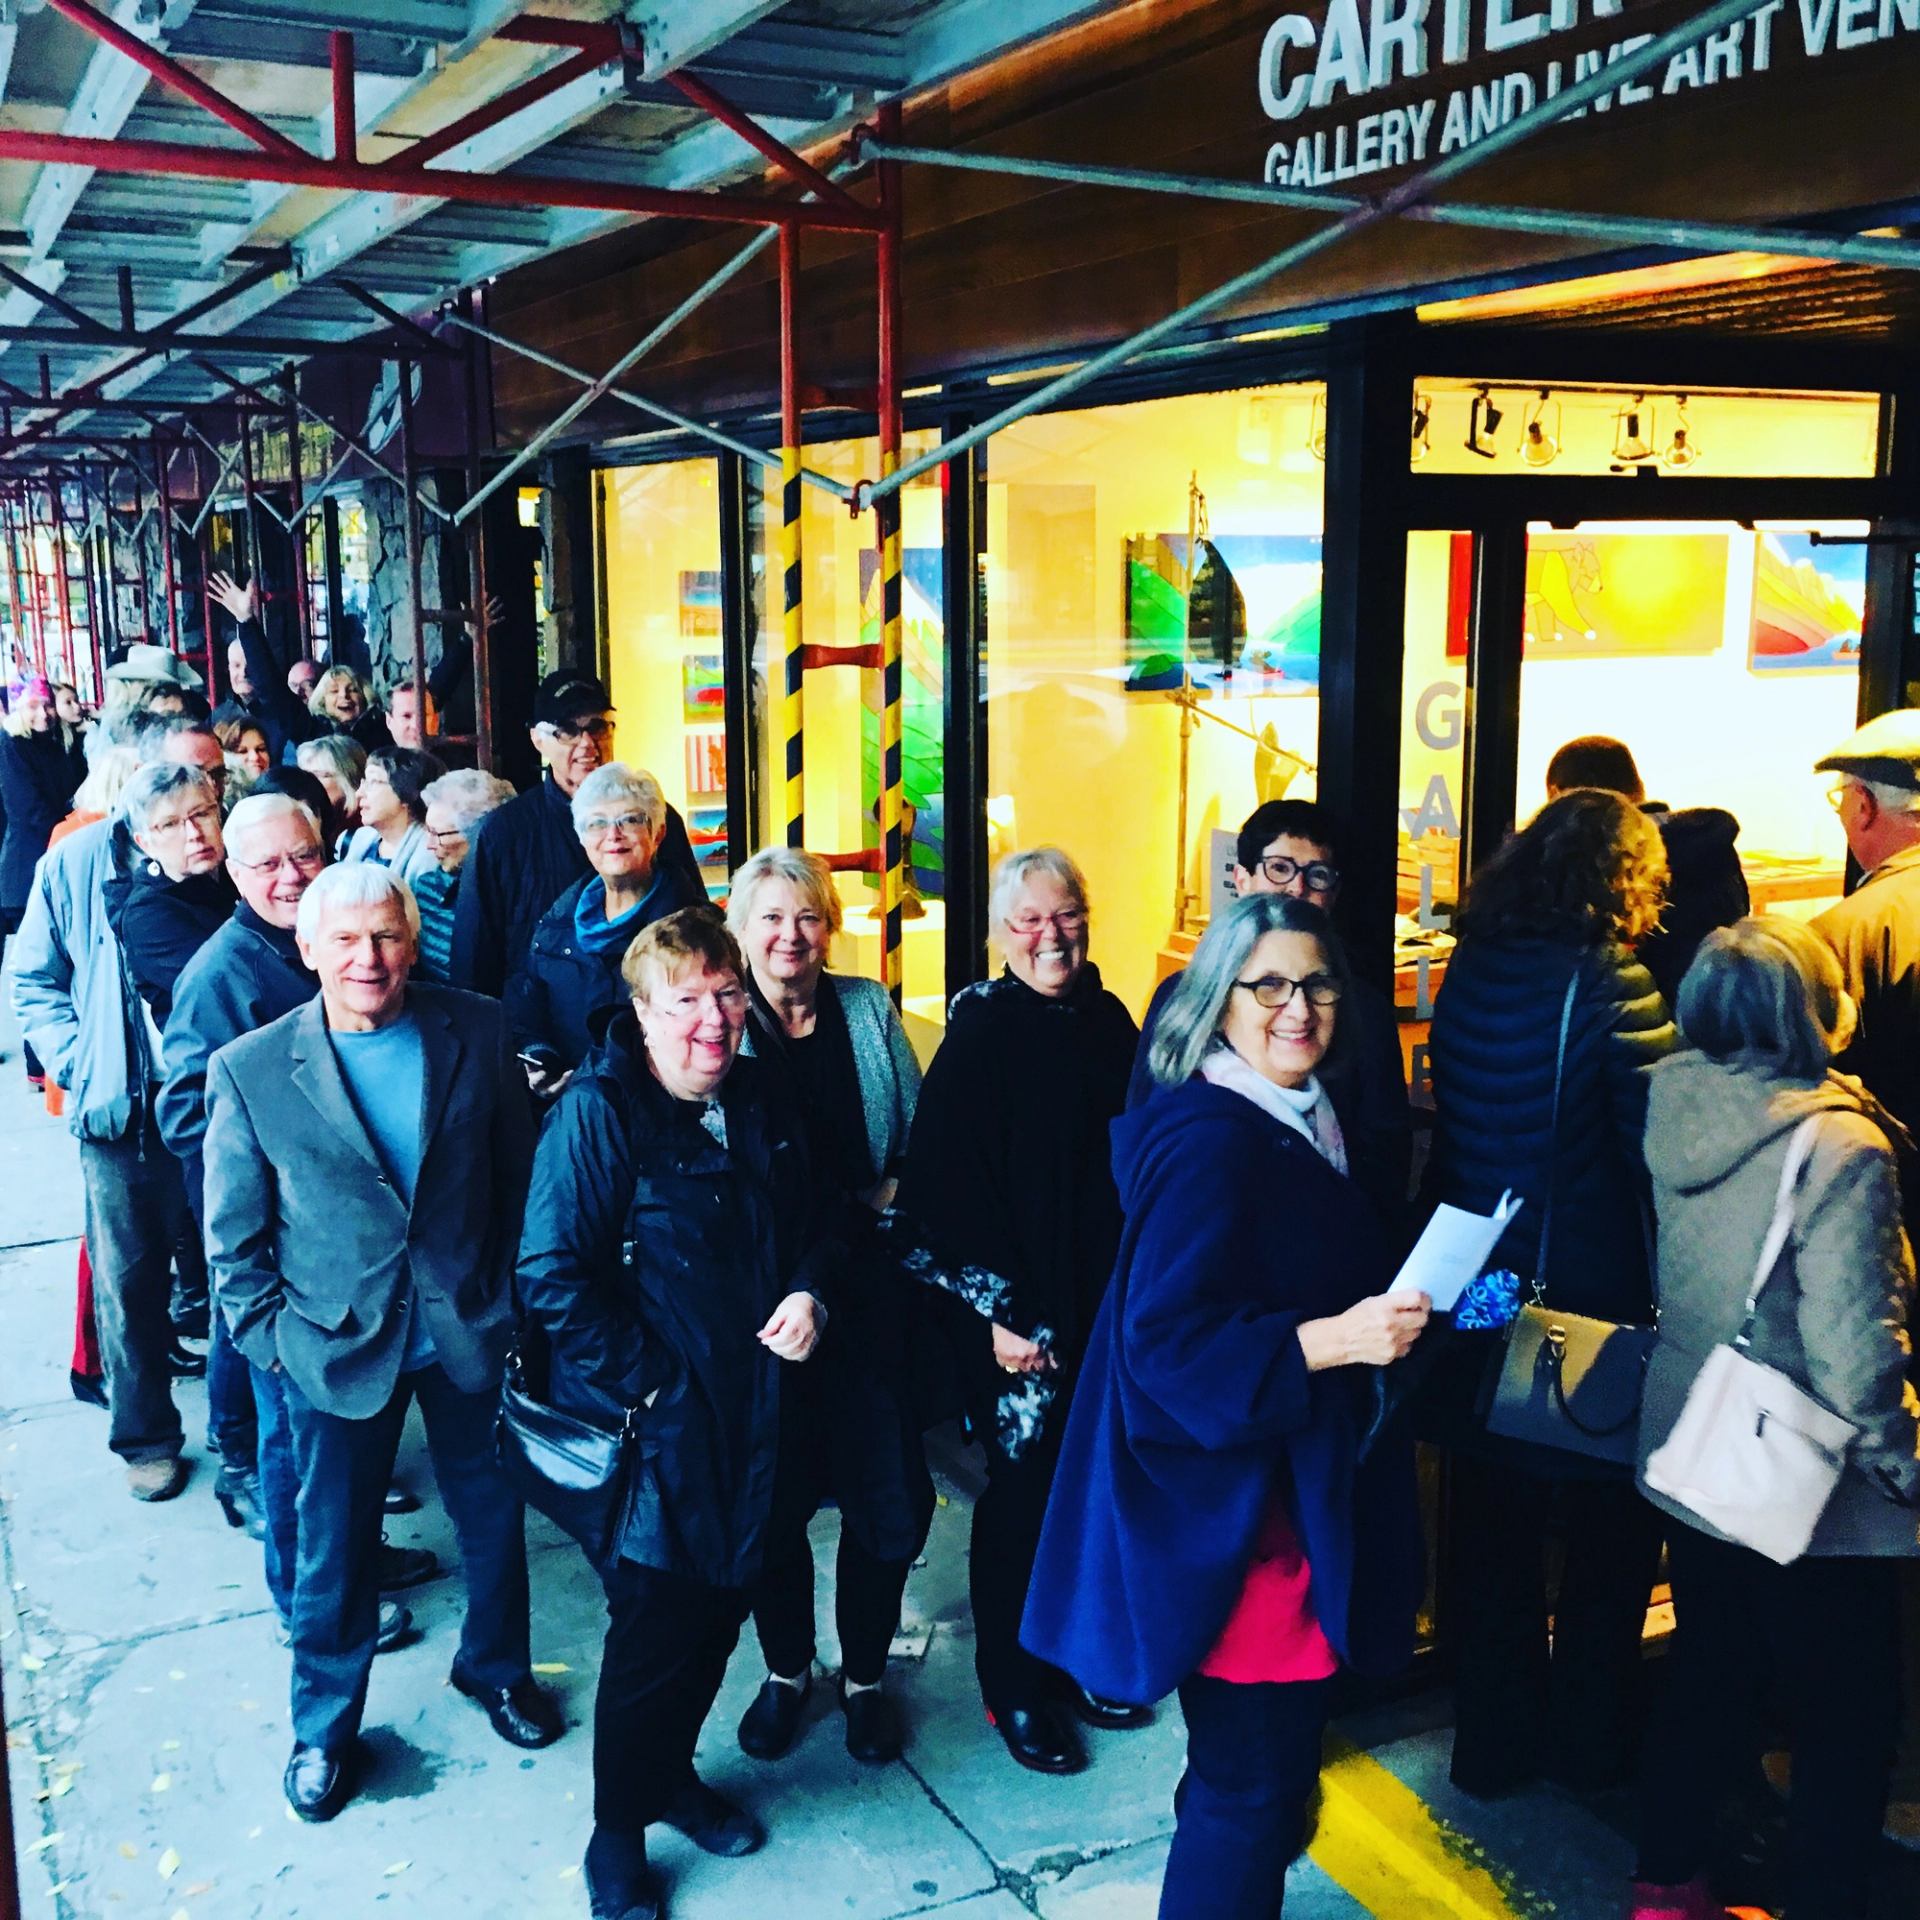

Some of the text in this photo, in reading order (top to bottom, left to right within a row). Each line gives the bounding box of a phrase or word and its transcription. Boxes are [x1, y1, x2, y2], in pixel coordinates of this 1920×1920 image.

[1258, 0, 1624, 120] CAR
[1264, 99, 1436, 187] GALLERY
[1439, 72, 1536, 153] AND
[1661, 0, 1785, 95] ART
